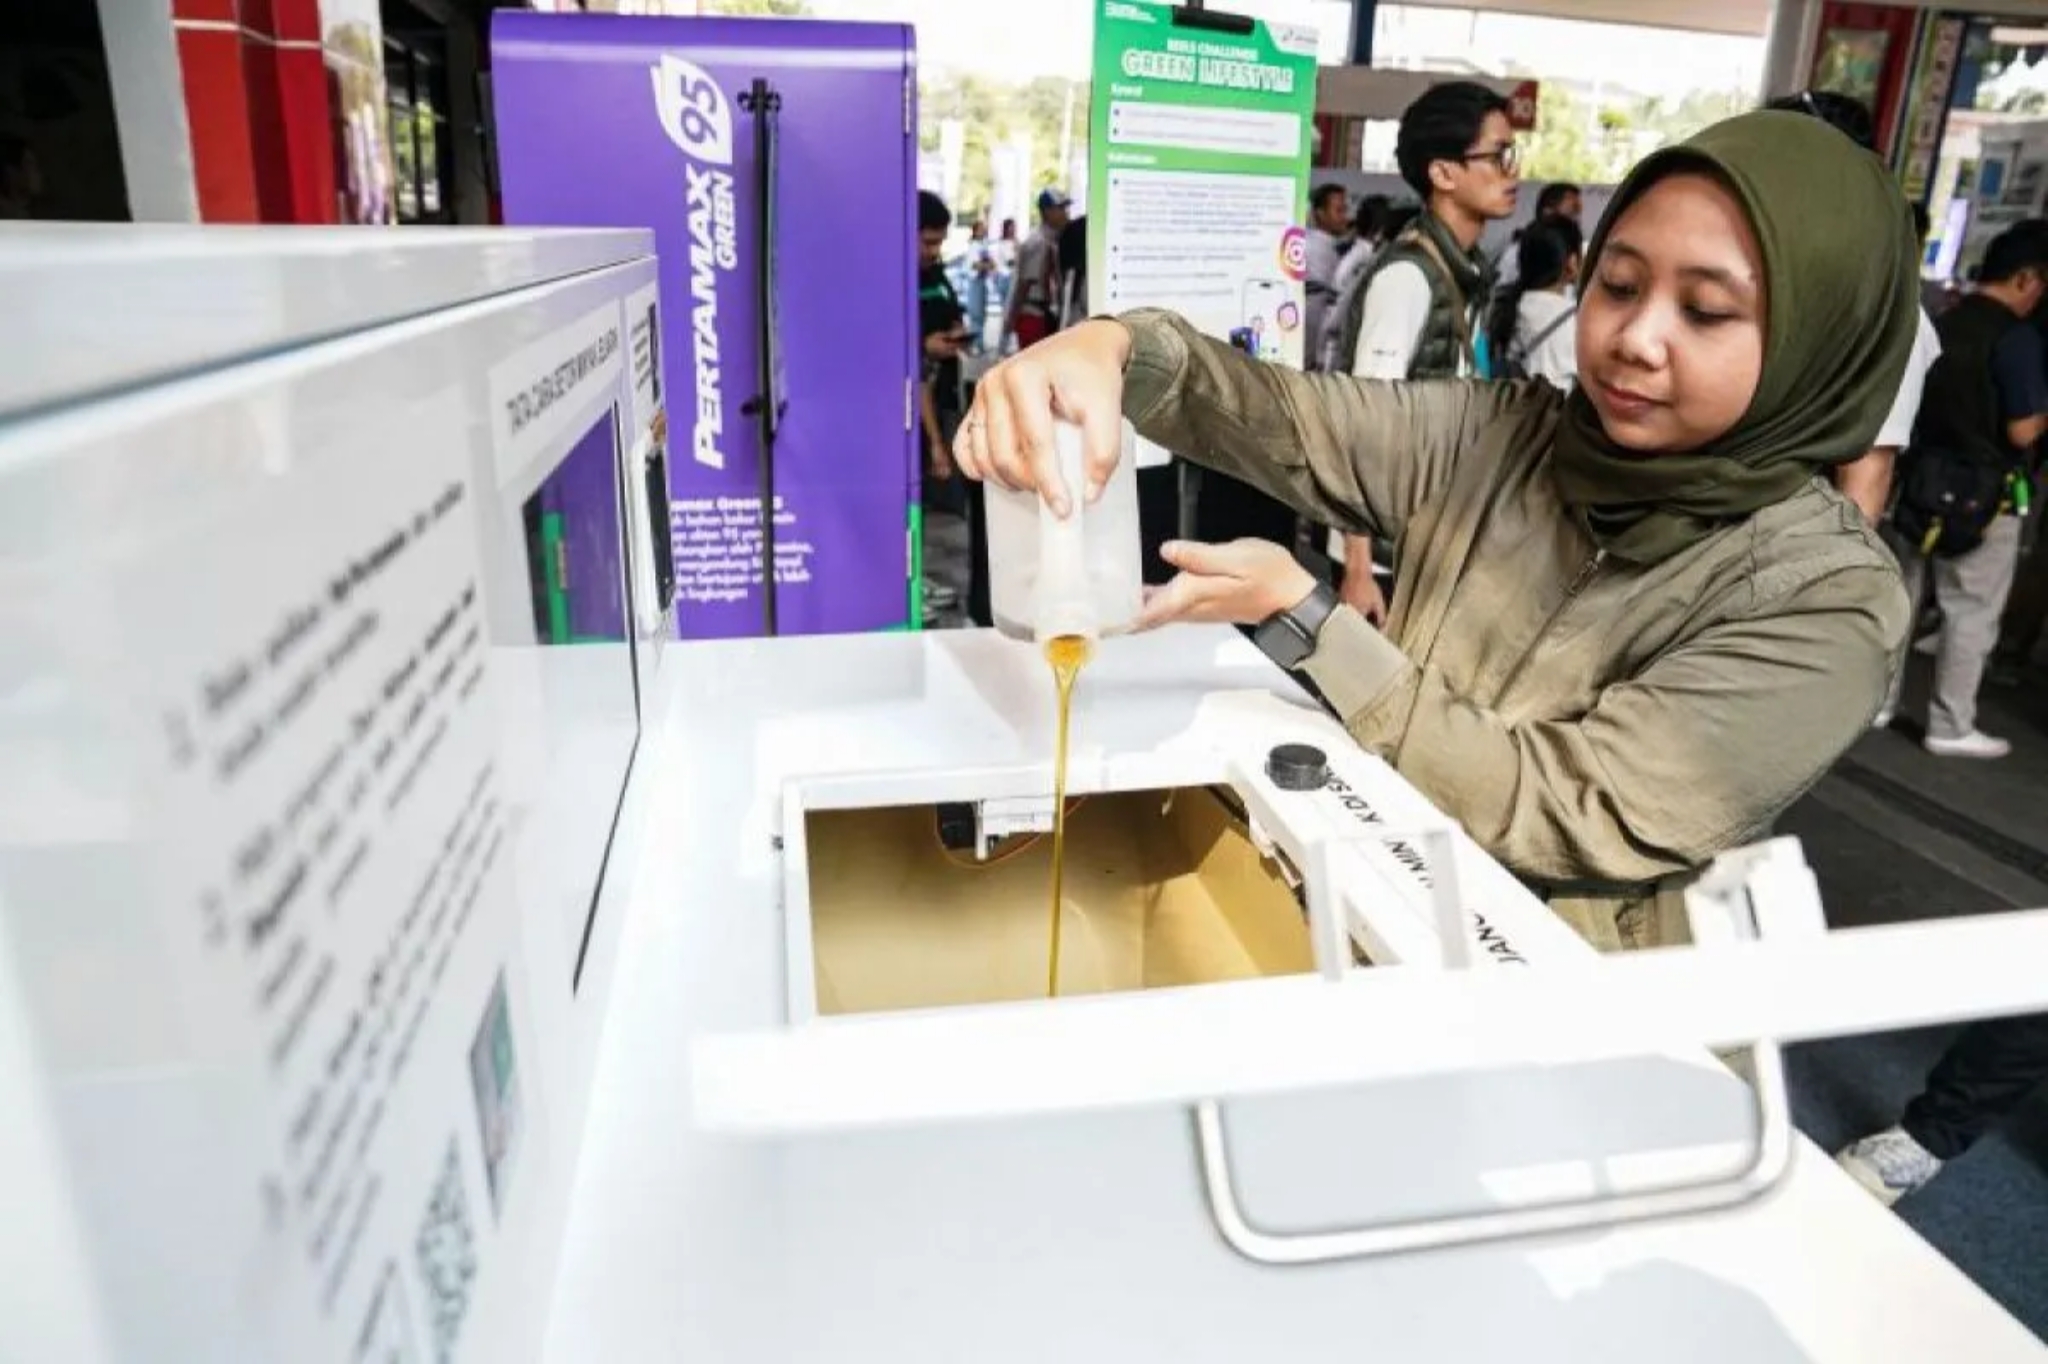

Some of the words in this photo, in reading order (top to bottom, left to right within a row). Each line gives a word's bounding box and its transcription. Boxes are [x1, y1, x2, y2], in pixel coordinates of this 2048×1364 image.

[680, 73, 719, 144] 95
[1121, 48, 1195, 82] GREEN
[1198, 57, 1294, 92] LIFESTYLE
[712, 169, 738, 270] GREEN
[686, 162, 724, 470] PERTAMAX
